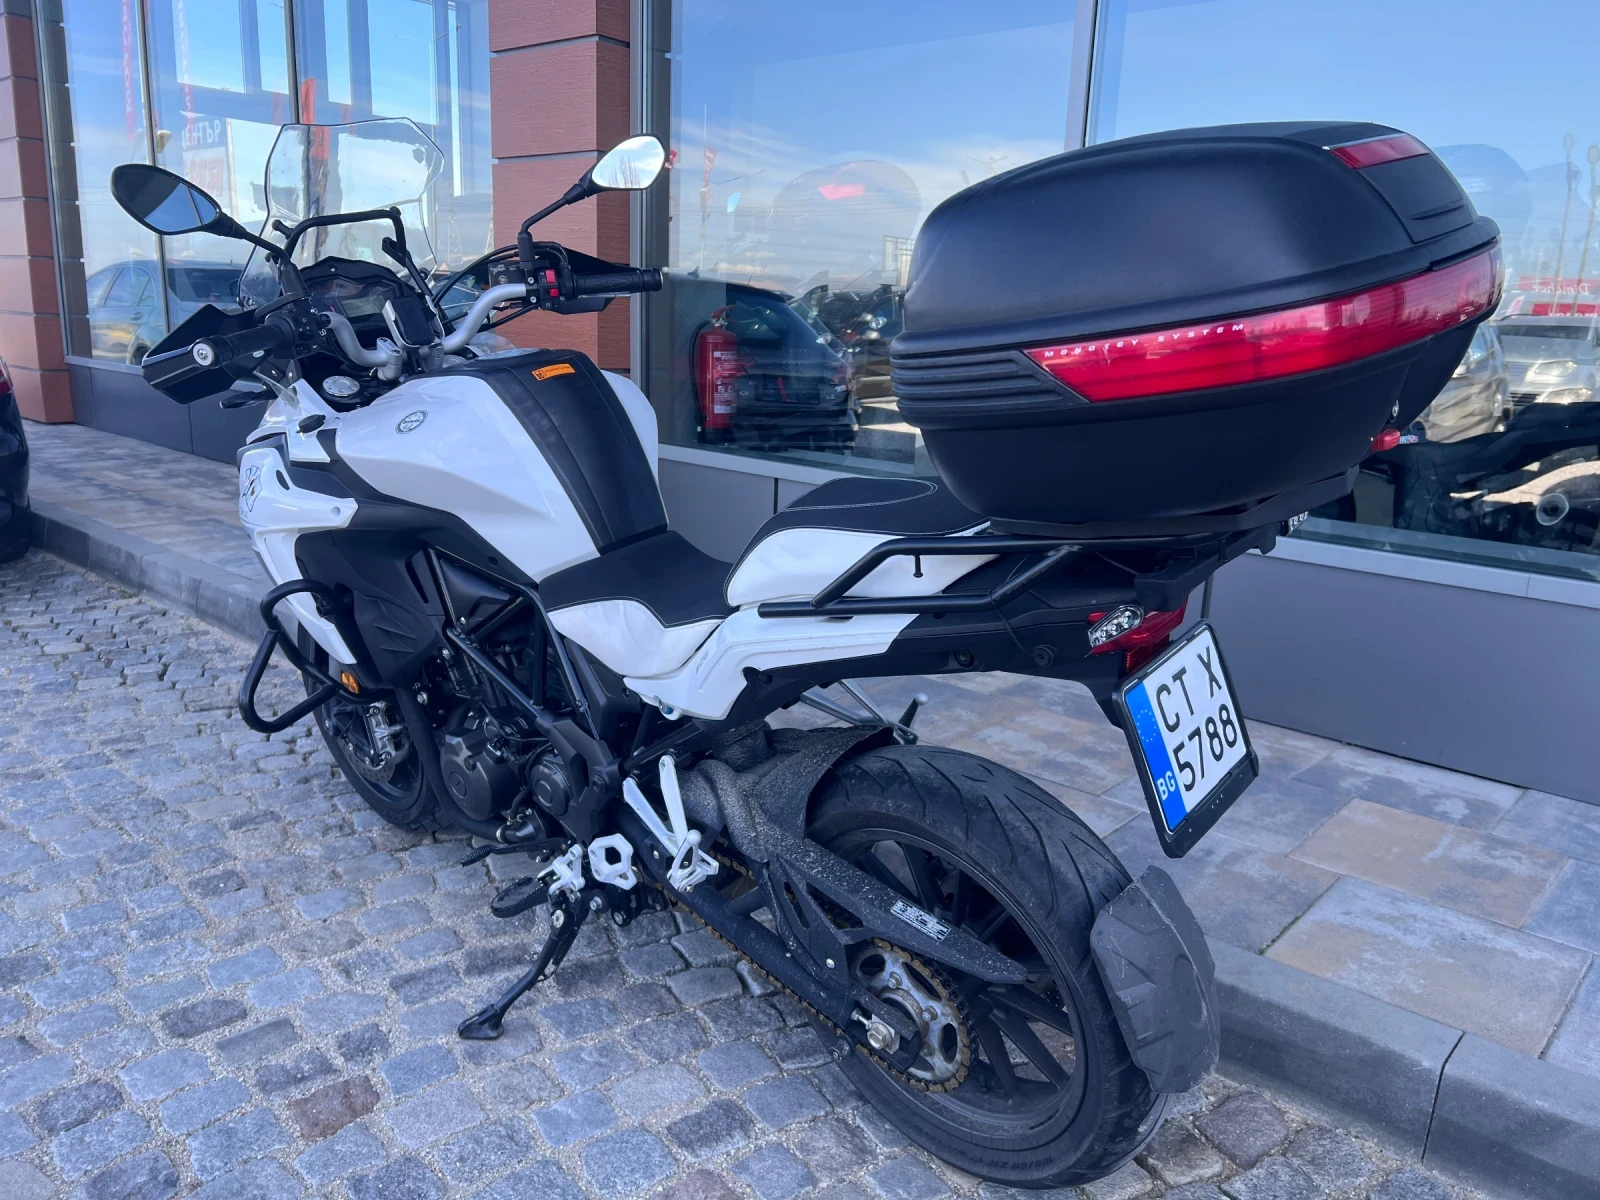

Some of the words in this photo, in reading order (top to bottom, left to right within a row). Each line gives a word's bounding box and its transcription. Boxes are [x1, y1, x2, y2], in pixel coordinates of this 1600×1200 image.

[1044, 339, 1139, 357] MONOKEY
[1158, 323, 1244, 342] SYSTEM
[1156, 666, 1195, 733] CT
[1197, 645, 1222, 698] X
[1172, 703, 1238, 792] 5788
[1156, 770, 1176, 801] BG
